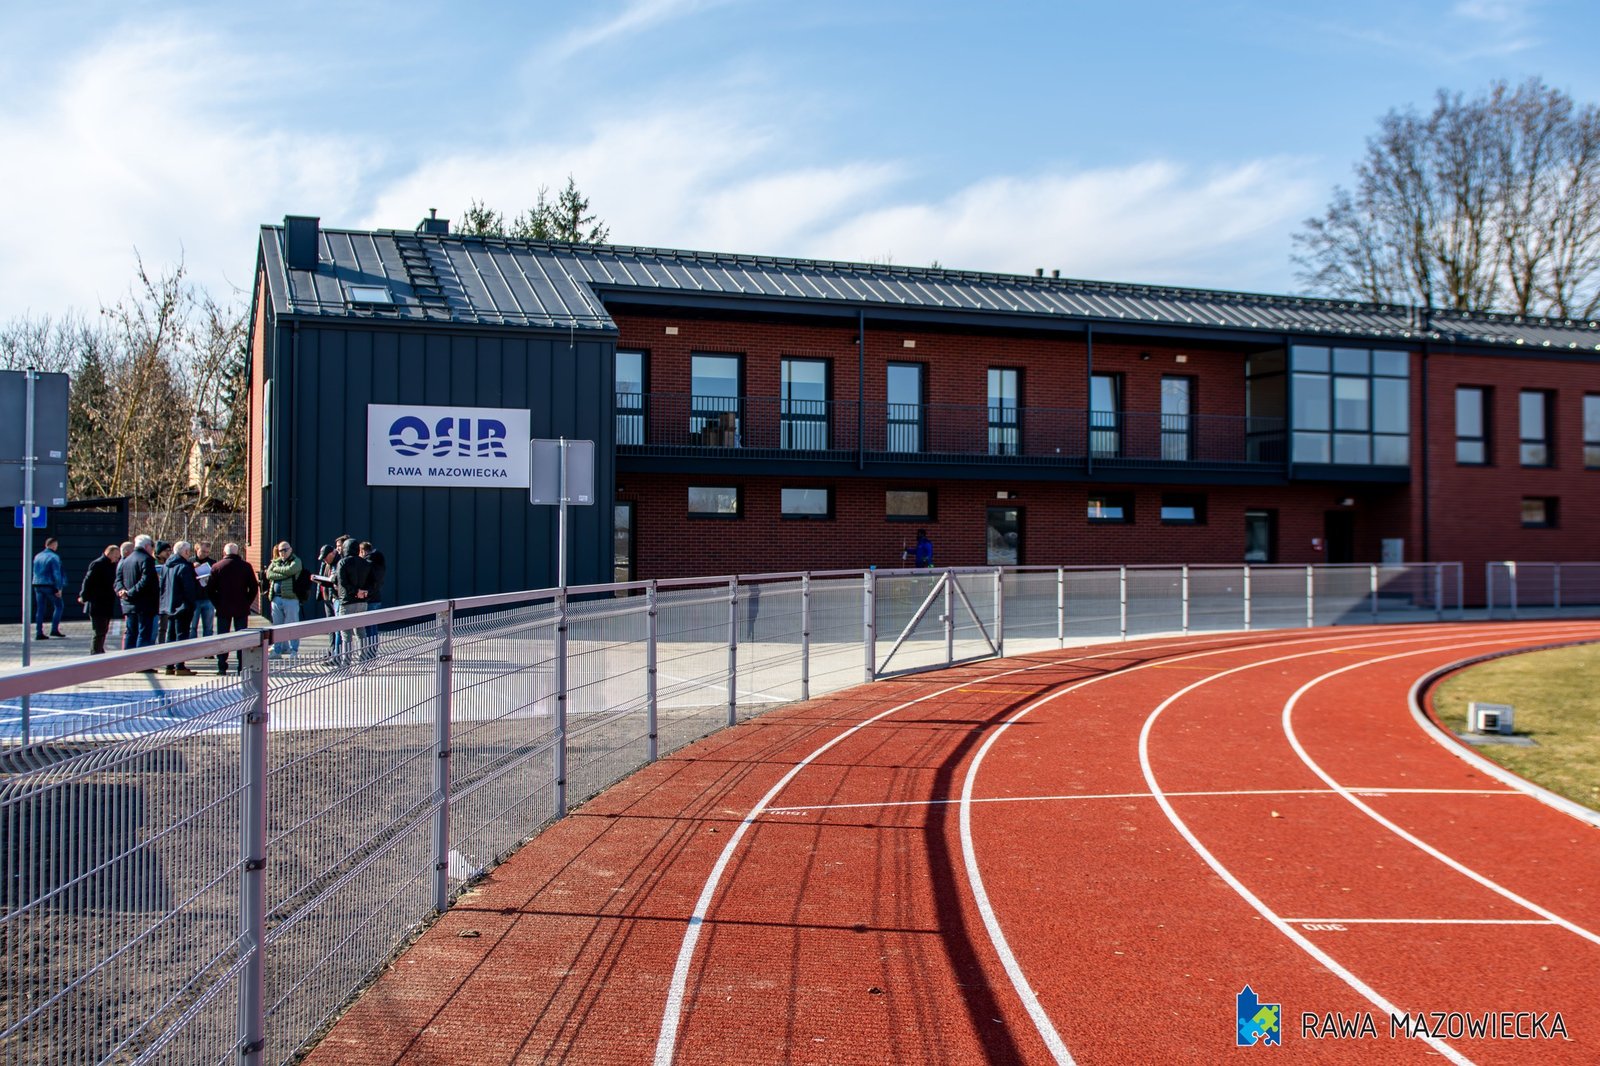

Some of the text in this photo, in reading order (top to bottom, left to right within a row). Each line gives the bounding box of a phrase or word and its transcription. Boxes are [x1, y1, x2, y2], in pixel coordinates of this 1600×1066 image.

[388, 415, 508, 458] OSIR
[388, 466, 508, 478] RAWA MAZOWIECKA
[1301, 923, 1348, 931] 300
